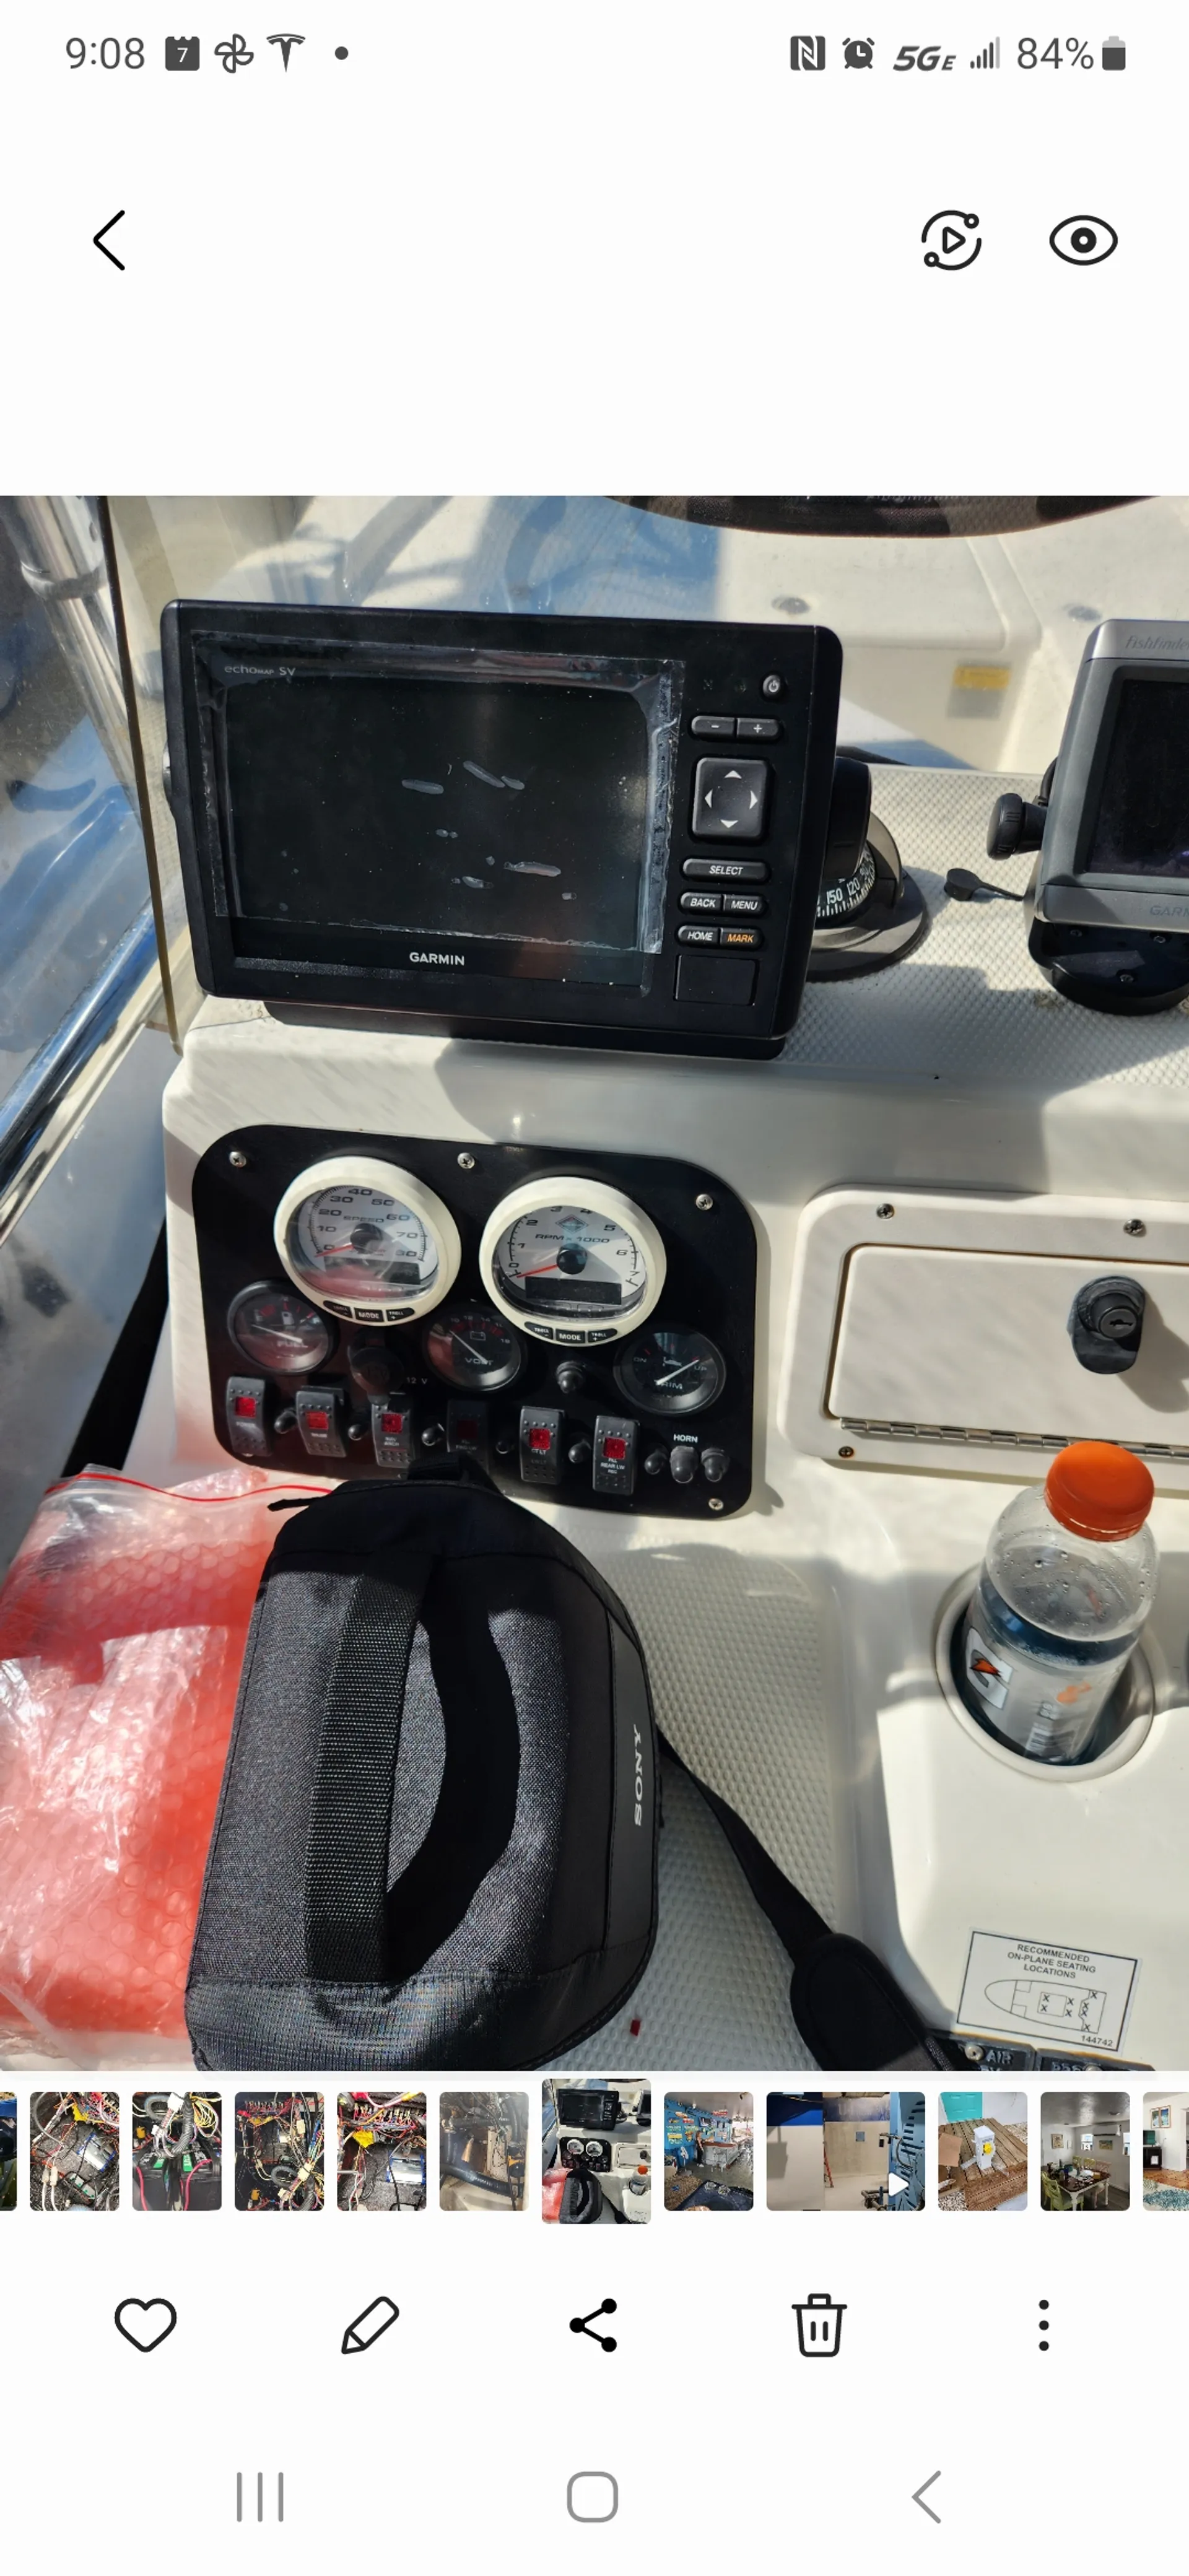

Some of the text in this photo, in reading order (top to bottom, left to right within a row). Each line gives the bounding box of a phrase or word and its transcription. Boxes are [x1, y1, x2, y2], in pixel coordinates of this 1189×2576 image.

[279, 667, 296, 676] SV
[709, 865, 743, 876] SELECT
[847, 877, 860, 896] 120
[826, 888, 843, 905] 150
[690, 898, 716, 908] BACK
[731, 900, 758, 910] MENU
[687, 931, 713, 941] HOME
[727, 933, 754, 943] MARK
[409, 952, 464, 966] GARMIN
[330, 1195, 354, 1203] 30
[318, 1208, 342, 1216] 20
[396, 1231, 418, 1239] 70
[673, 1434, 698, 1443] HORN
[634, 1724, 643, 1826] SONY
[1017, 1944, 1090, 1963] RECOMMENDED
[1008, 1951, 1096, 1973] ON-PLANE SEATING
[1024, 1964, 1076, 1979] LOCATIONS
[1081, 2035, 1113, 2047] 144742
[986, 2050, 1013, 2064] AIR
